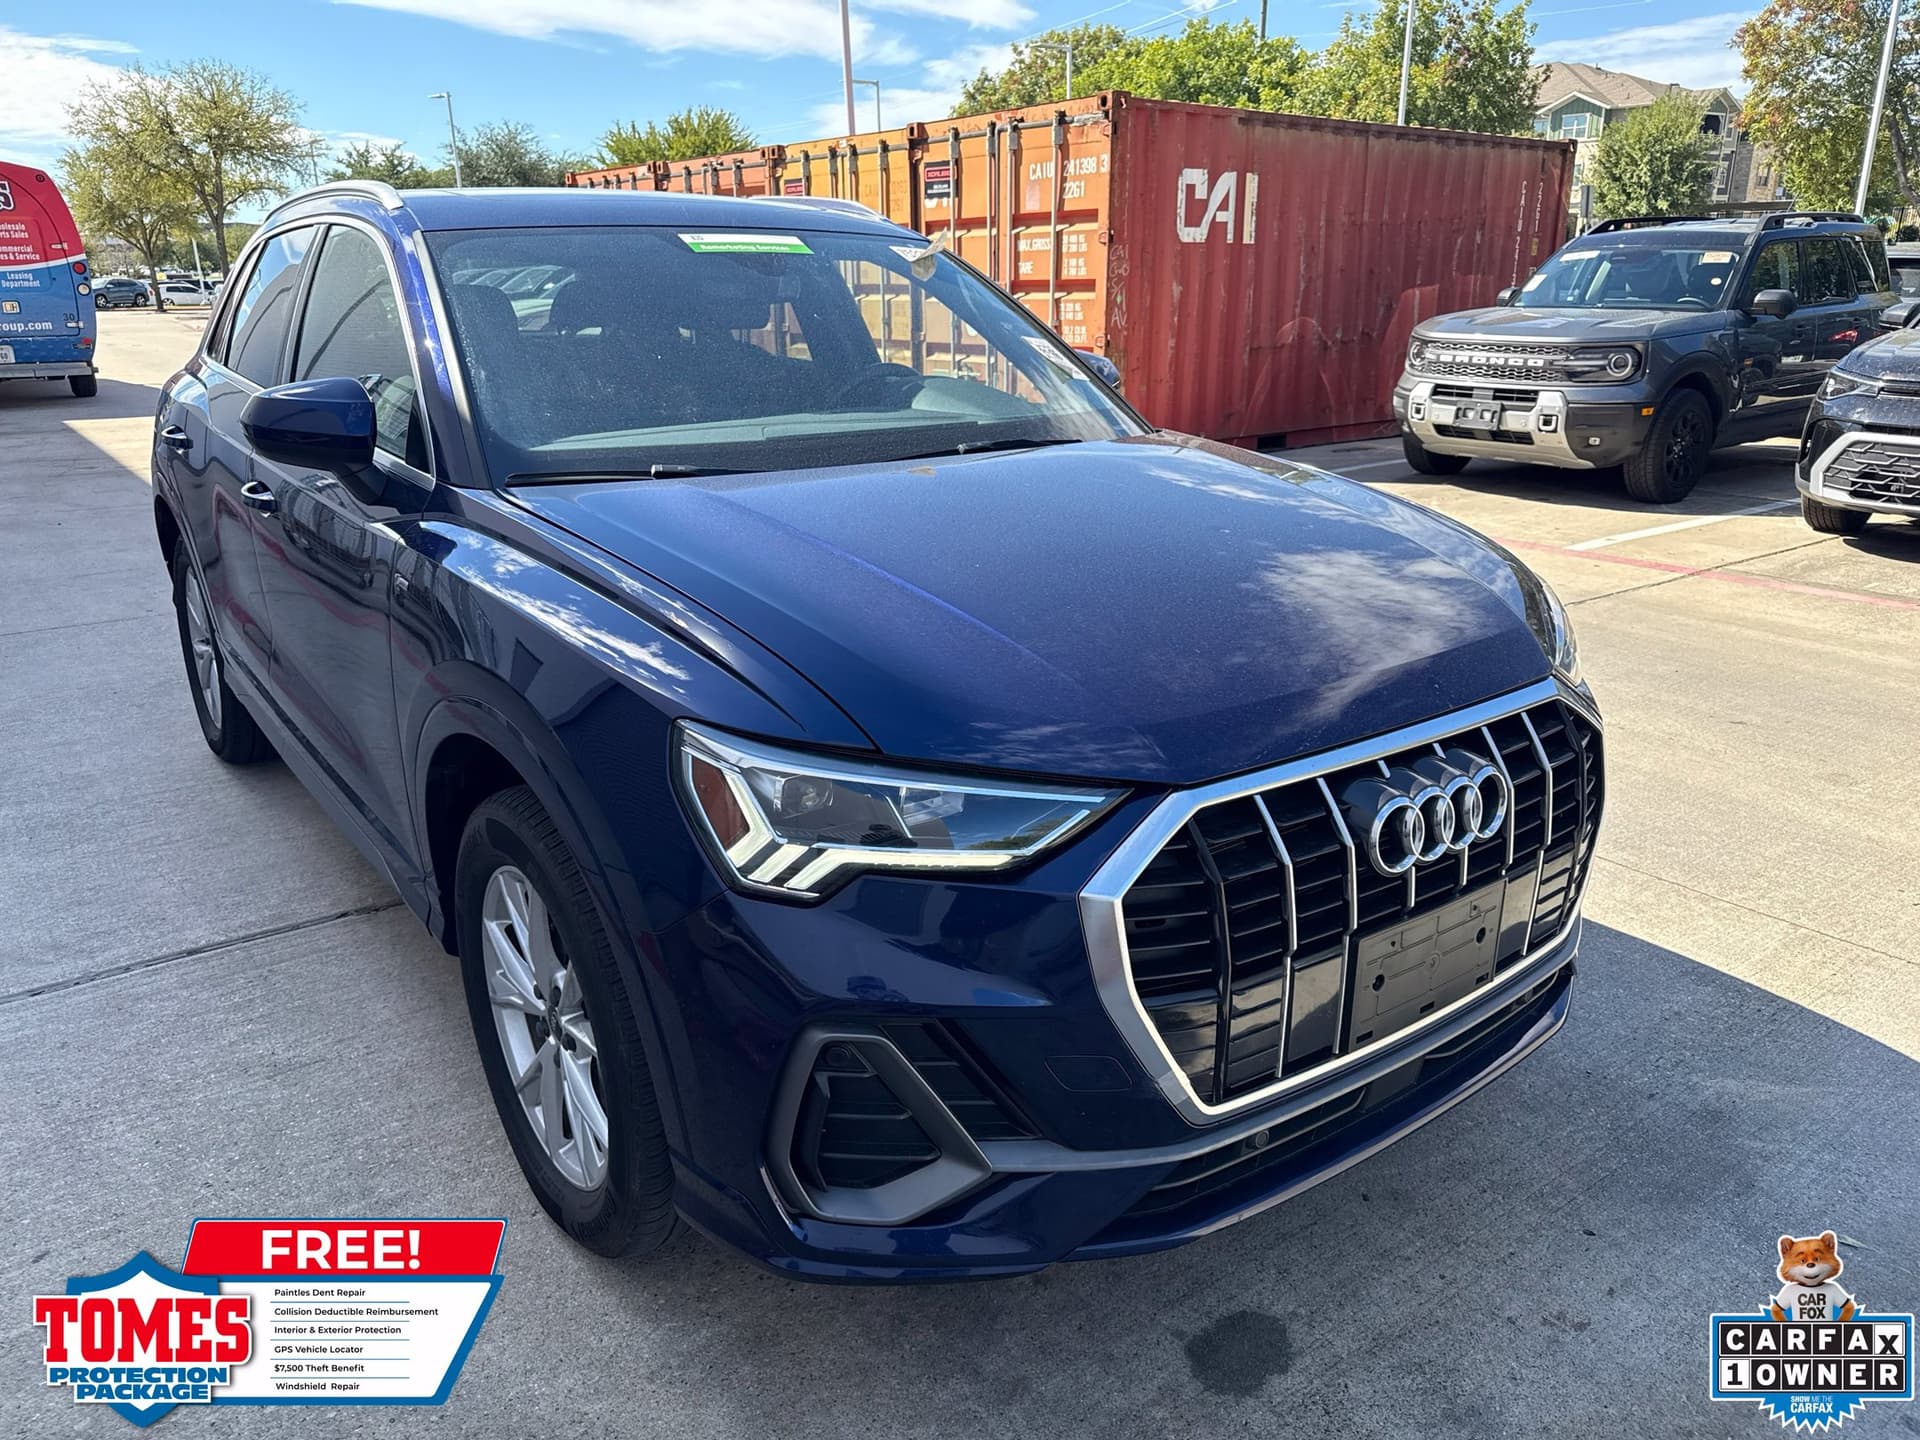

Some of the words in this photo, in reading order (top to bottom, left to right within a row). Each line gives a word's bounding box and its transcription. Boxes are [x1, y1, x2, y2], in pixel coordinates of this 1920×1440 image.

[1029, 161, 1053, 180] CAIU
[1063, 156, 1097, 177] 241398
[1101, 153, 1109, 173] 3
[1177, 168, 1258, 244] CAI
[0, 222, 25, 231] olesale
[0, 244, 33, 253] mmercial
[15, 252, 40, 261] Service
[7, 271, 33, 281] Leasing
[1, 280, 40, 288] Department
[1440, 353, 1544, 367] BRONCO
